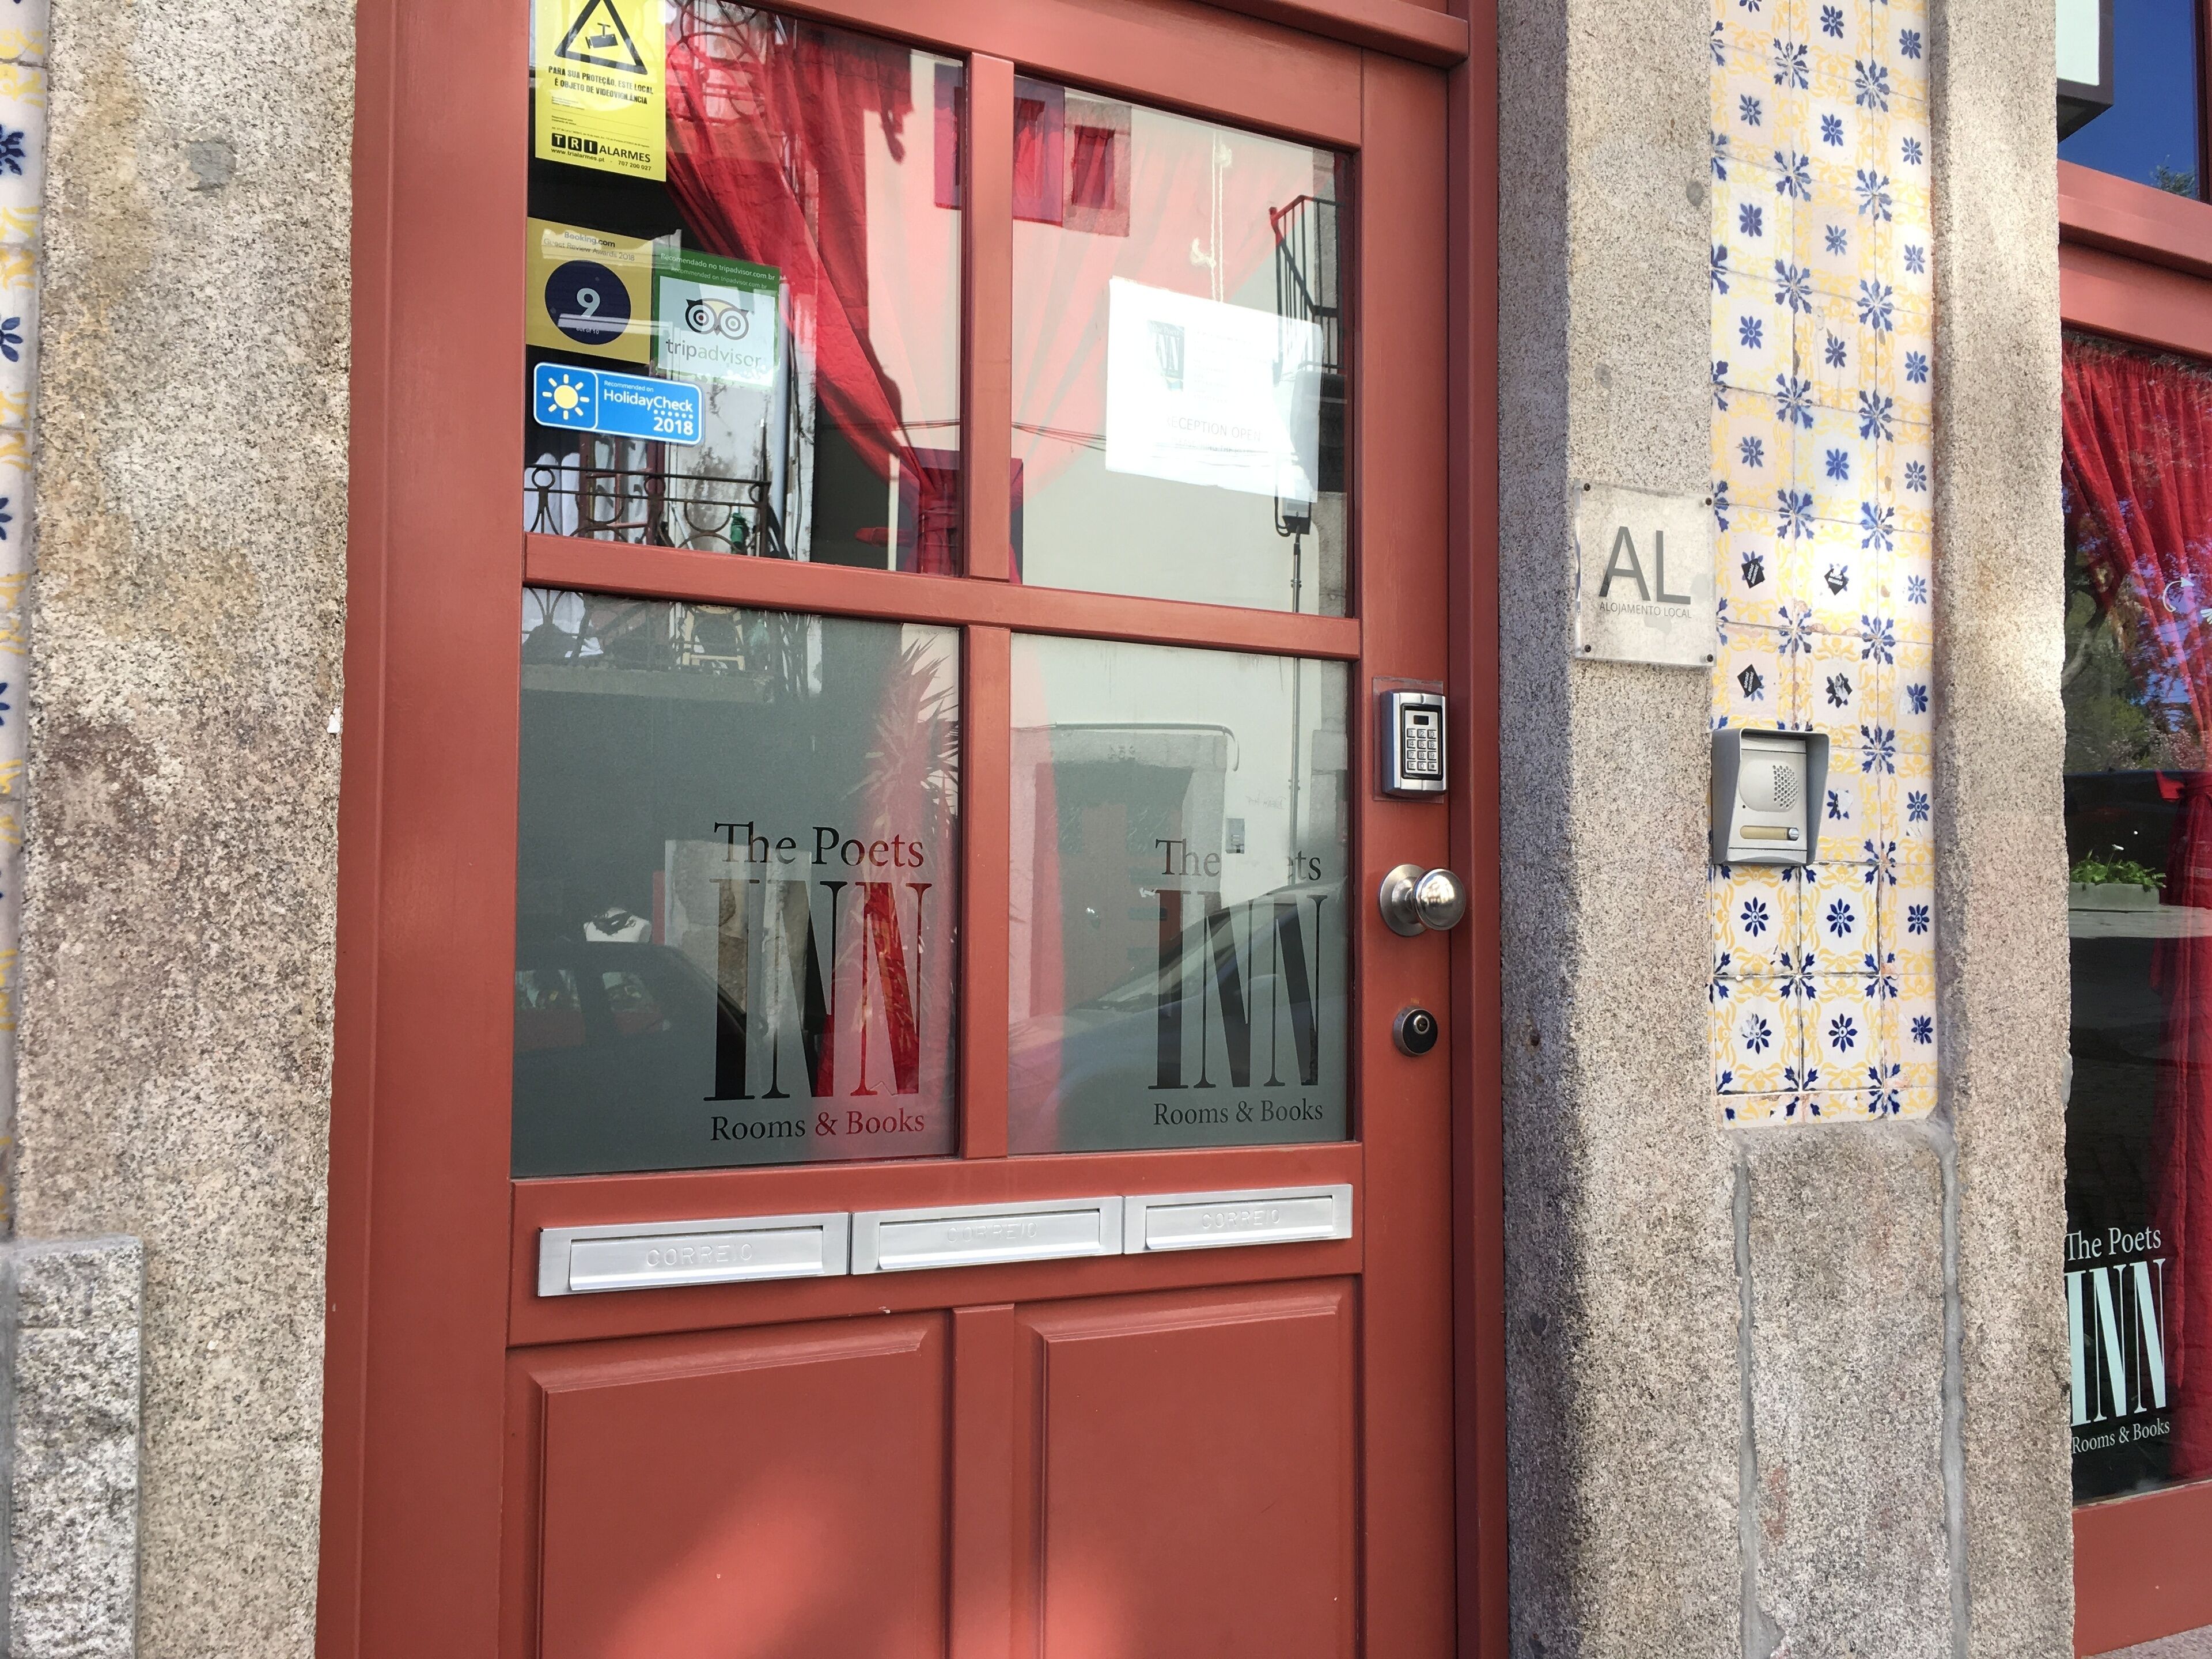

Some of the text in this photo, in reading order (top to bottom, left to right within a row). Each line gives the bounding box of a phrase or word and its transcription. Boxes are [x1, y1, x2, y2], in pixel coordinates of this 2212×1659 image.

[548, 66, 566, 76] PARA
[567, 70, 580, 79] SUA
[618, 80, 632, 90] ESTE
[634, 84, 653, 94] LOCAL
[555, 77, 558, 86] É
[560, 79, 585, 91] OBJETO
[586, 85, 594, 93] DE
[596, 87, 647, 104] VIDEOVIGILÂNCIA
[599, 145, 651, 163] ALARMES
[543, 238, 635, 261] Guest Review Awards 2018
[564, 231, 616, 248] Booking.com
[661, 253, 707, 268] Recomendado
[671, 267, 711, 279] Recommended
[577, 287, 600, 318] 9
[665, 339, 762, 368] tripadvisor
[604, 380, 645, 391] Recommended
[604, 389, 694, 412] HolidayCheck
[653, 416, 694, 435] 2018
[1232, 426, 1260, 442] OPEN
[1599, 526, 1691, 605] AL
[1599, 601, 1692, 619] ALOJAMENTO LOCAL
[714, 820, 925, 868] The Poets
[1155, 838, 1220, 877] The
[703, 878, 933, 1101] INN
[1147, 889, 1328, 1090] INN
[710, 1107, 925, 1141] Rooms & Books
[1153, 1098, 1323, 1126] Rooms & Books
[1202, 1209, 1281, 1229] CORREIO
[947, 1222, 1037, 1244] CORREIO
[2065, 1226, 2161, 1262] The Poets
[646, 1243, 753, 1267] CORREIO
[2064, 1258, 2166, 1427] INN
[2072, 1418, 2171, 1454] Rooms & Books
